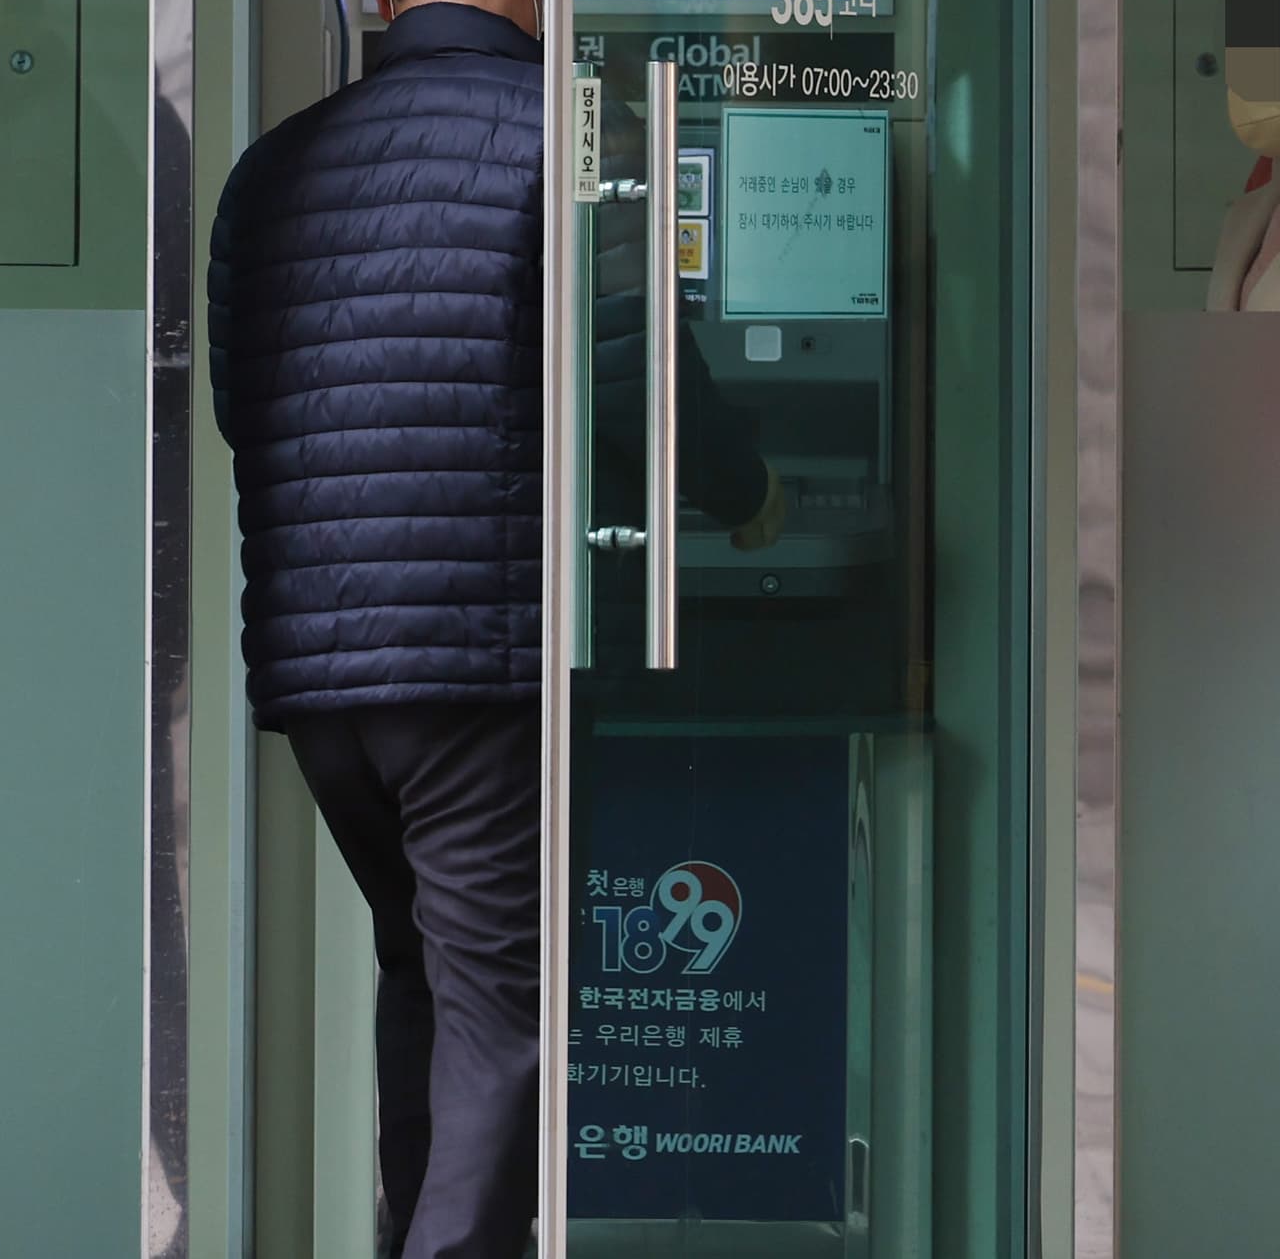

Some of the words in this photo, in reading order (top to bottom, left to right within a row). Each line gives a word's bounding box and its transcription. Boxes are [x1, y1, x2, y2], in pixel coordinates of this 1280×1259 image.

[650, 35, 761, 68] Global
[802, 66, 919, 100] 07:00~23:30
[581, 87, 595, 173] 당기시오
[579, 180, 597, 191] PULL
[738, 176, 776, 193] 거래중인
[780, 176, 809, 194] 손님이
[837, 177, 856, 194] 경우
[738, 212, 757, 230] 잠시
[762, 212, 799, 230] 대기하여
[803, 213, 831, 231] 주시기
[836, 213, 873, 231] 바랍니다
[586, 869, 609, 897] 첫
[612, 877, 645, 898] 은행
[593, 867, 738, 975] 1899
[579, 986, 766, 1012] 한국전자금융에서
[595, 1024, 686, 1047] 우리은행
[699, 1026, 744, 1049] 제휴
[574, 1124, 649, 1161] 은행
[655, 1133, 732, 1155] WOORI
[733, 1134, 803, 1155] BANK
